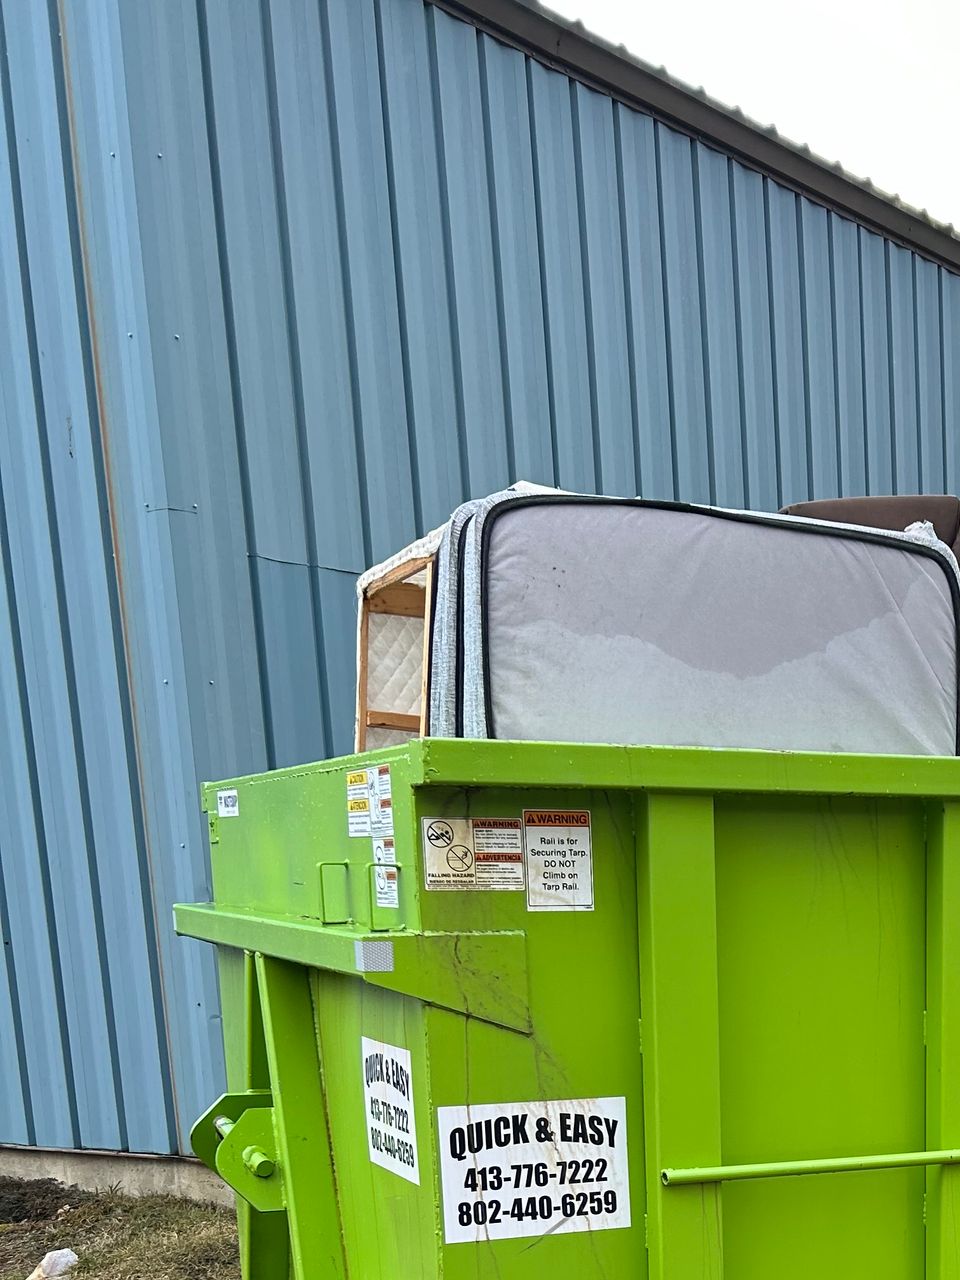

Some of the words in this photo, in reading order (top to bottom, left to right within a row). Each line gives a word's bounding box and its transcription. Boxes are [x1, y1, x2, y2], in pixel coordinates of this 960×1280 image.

[537, 814, 588, 824] WARNING
[540, 837, 556, 845] Rail
[558, 837, 565, 845] is
[567, 837, 578, 845] for
[531, 849, 567, 858] Securing
[569, 849, 588, 858] Tarp.
[544, 860, 557, 868] DO
[559, 860, 576, 868] NOT
[543, 871, 566, 879] Climb
[542, 883, 560, 891] Tarp
[562, 883, 579, 891] Rail.
[365, 1053, 385, 1088] QUICK
[385, 1059, 392, 1085] &
[391, 1058, 410, 1101] EASY
[370, 1097, 410, 1134] 413-776-7222
[371, 1127, 414, 1168] 802-440-6259
[449, 1114, 530, 1161] QUICK
[535, 1117, 554, 1143] &
[559, 1113, 618, 1148] EASY
[464, 1158, 608, 1192] 413-776-7222
[458, 1190, 617, 1226] 802-440-6259
